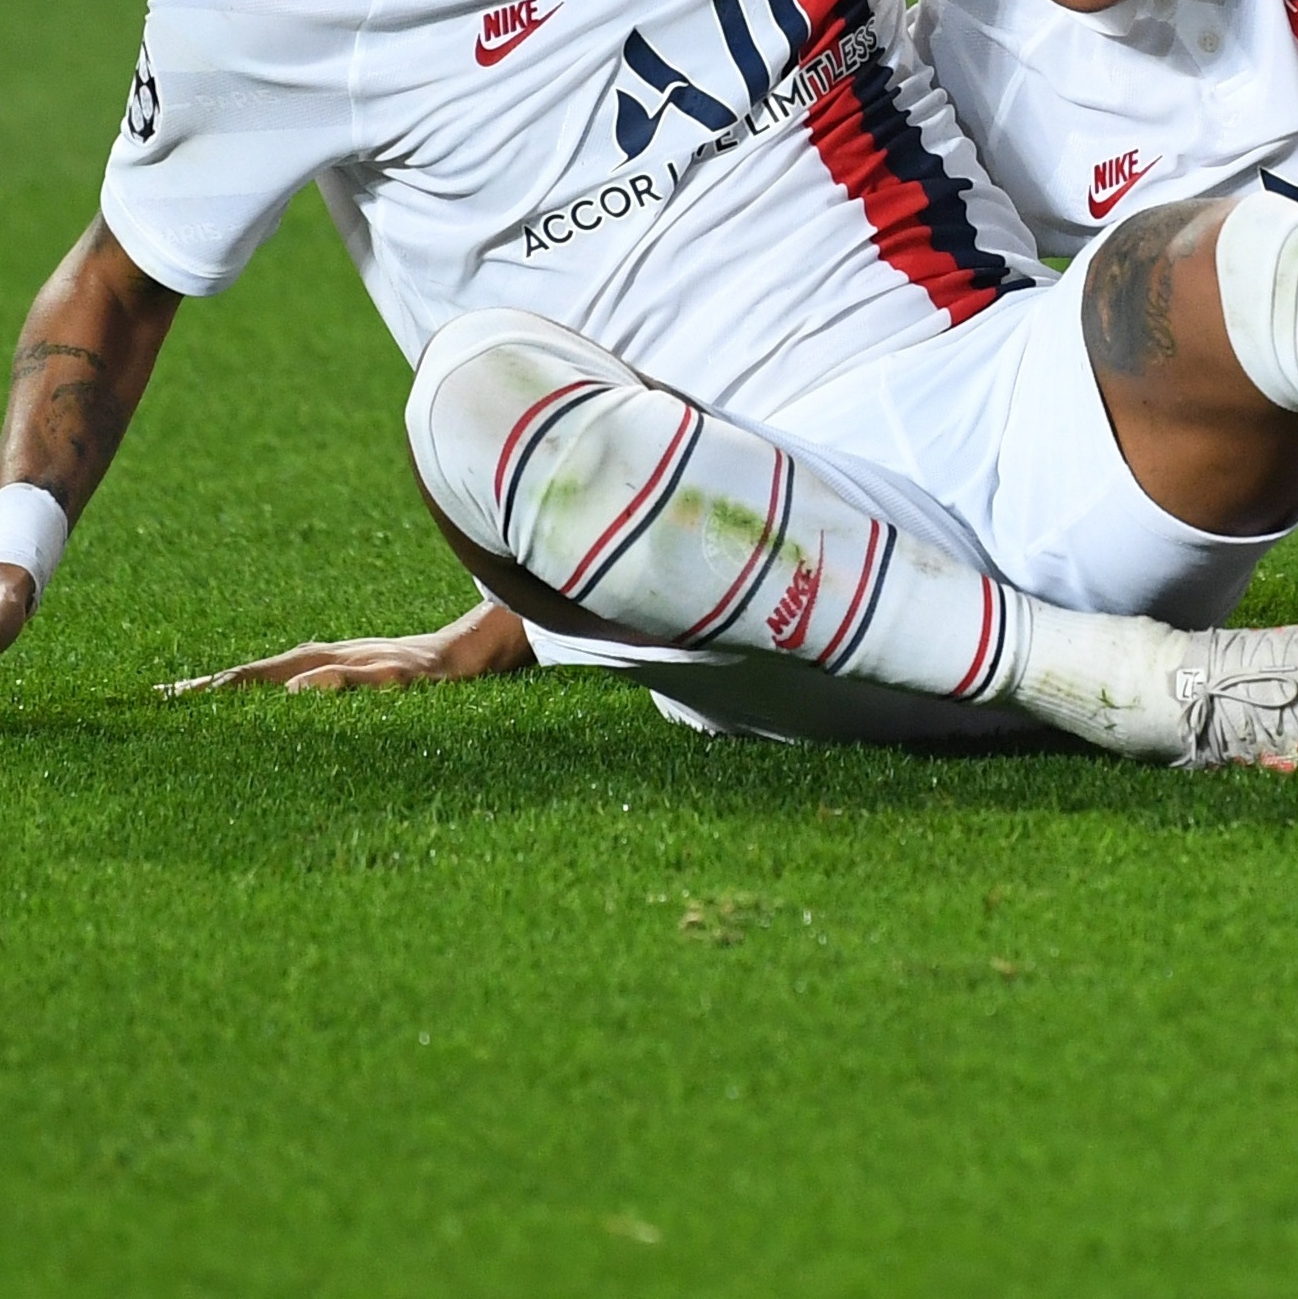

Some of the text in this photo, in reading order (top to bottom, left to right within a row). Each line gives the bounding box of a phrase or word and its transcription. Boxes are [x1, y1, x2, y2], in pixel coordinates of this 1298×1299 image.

[524, 174, 662, 259] ACCOR
[743, 15, 878, 136] LIMITLESS
[1093, 148, 1141, 195] NIKE
[766, 558, 814, 636] NIKE
